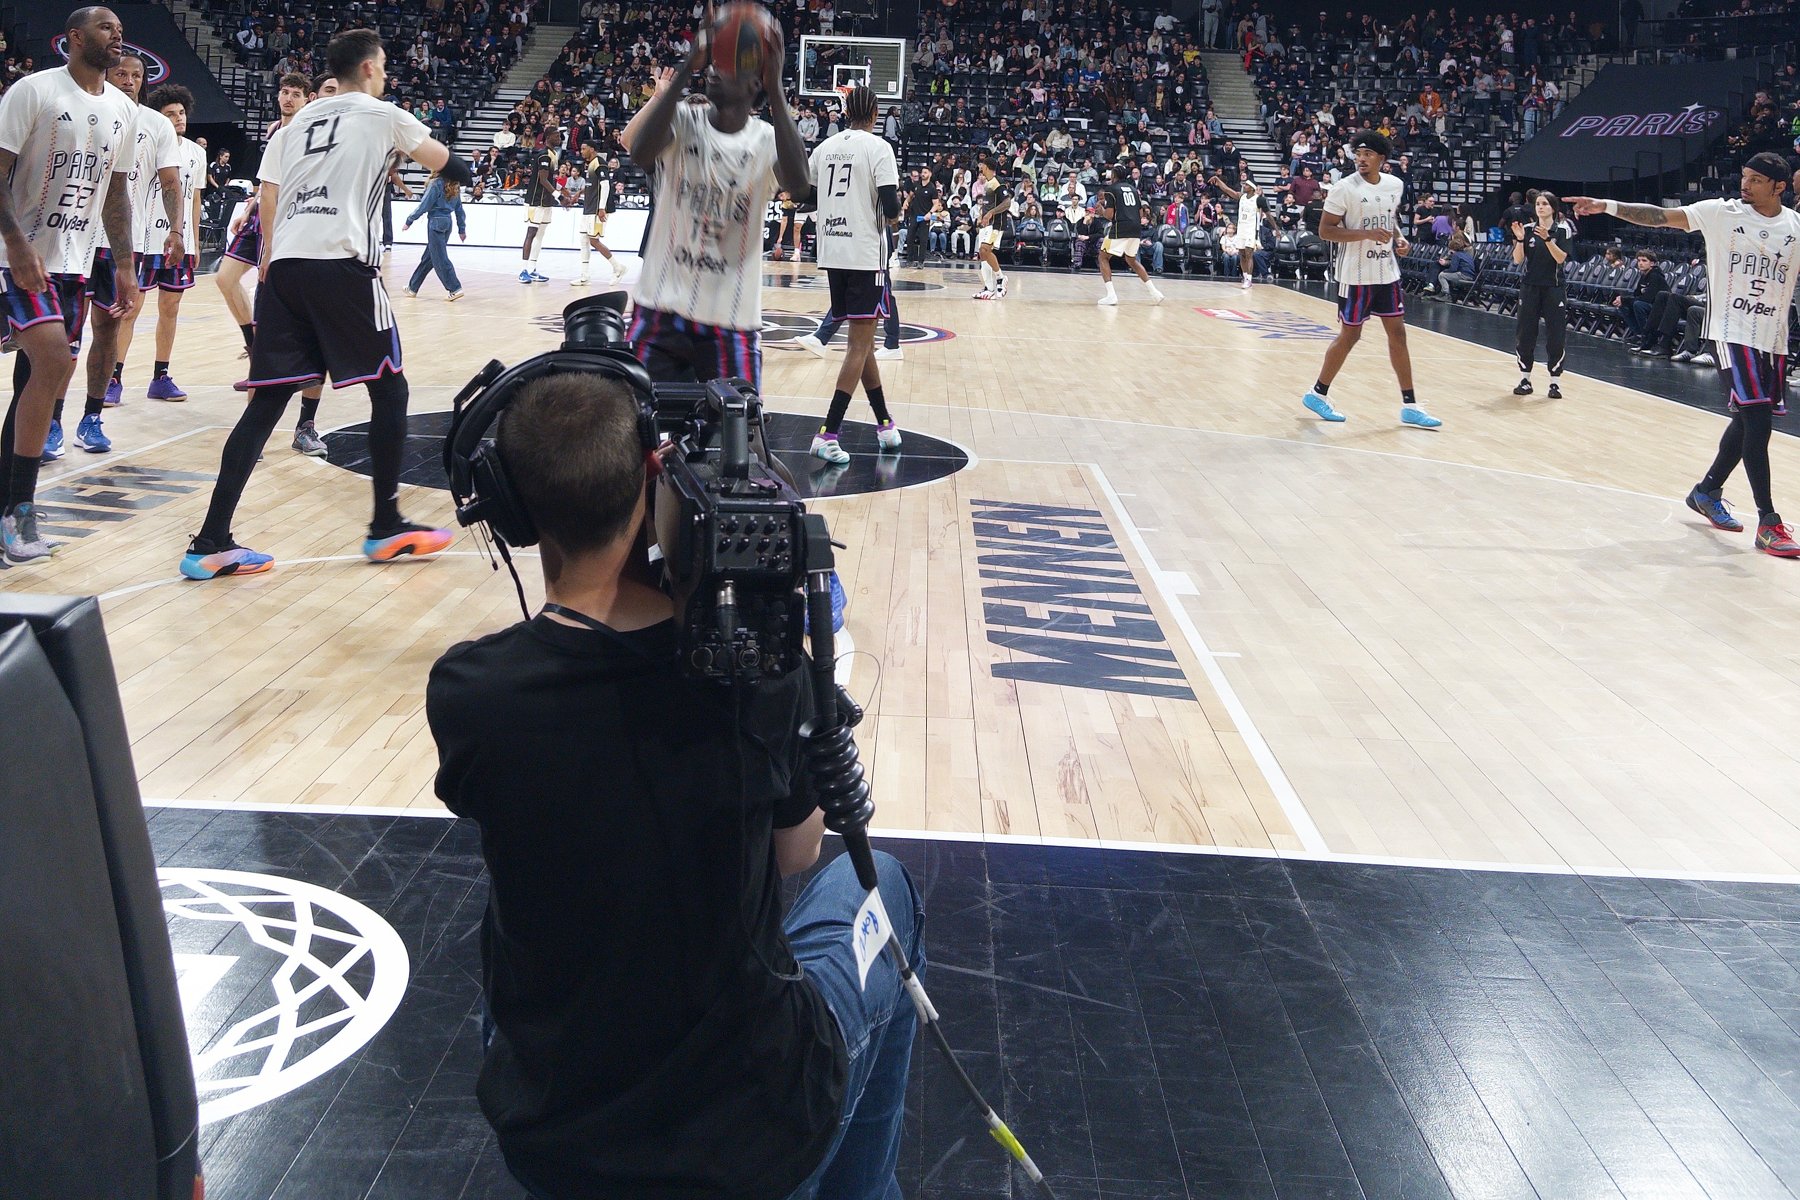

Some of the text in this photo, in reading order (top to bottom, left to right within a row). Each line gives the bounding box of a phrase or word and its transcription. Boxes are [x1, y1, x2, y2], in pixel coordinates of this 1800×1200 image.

[1559, 104, 1720, 137] PARIS
[825, 163, 852, 198] 13
[58, 184, 96, 209] 22
[1122, 191, 1136, 207] 00
[46, 212, 90, 234] OlyBet
[825, 217, 847, 229] PIZZA
[1728, 249, 1790, 285] PARIS
[1733, 297, 1777, 318] OlyBet
